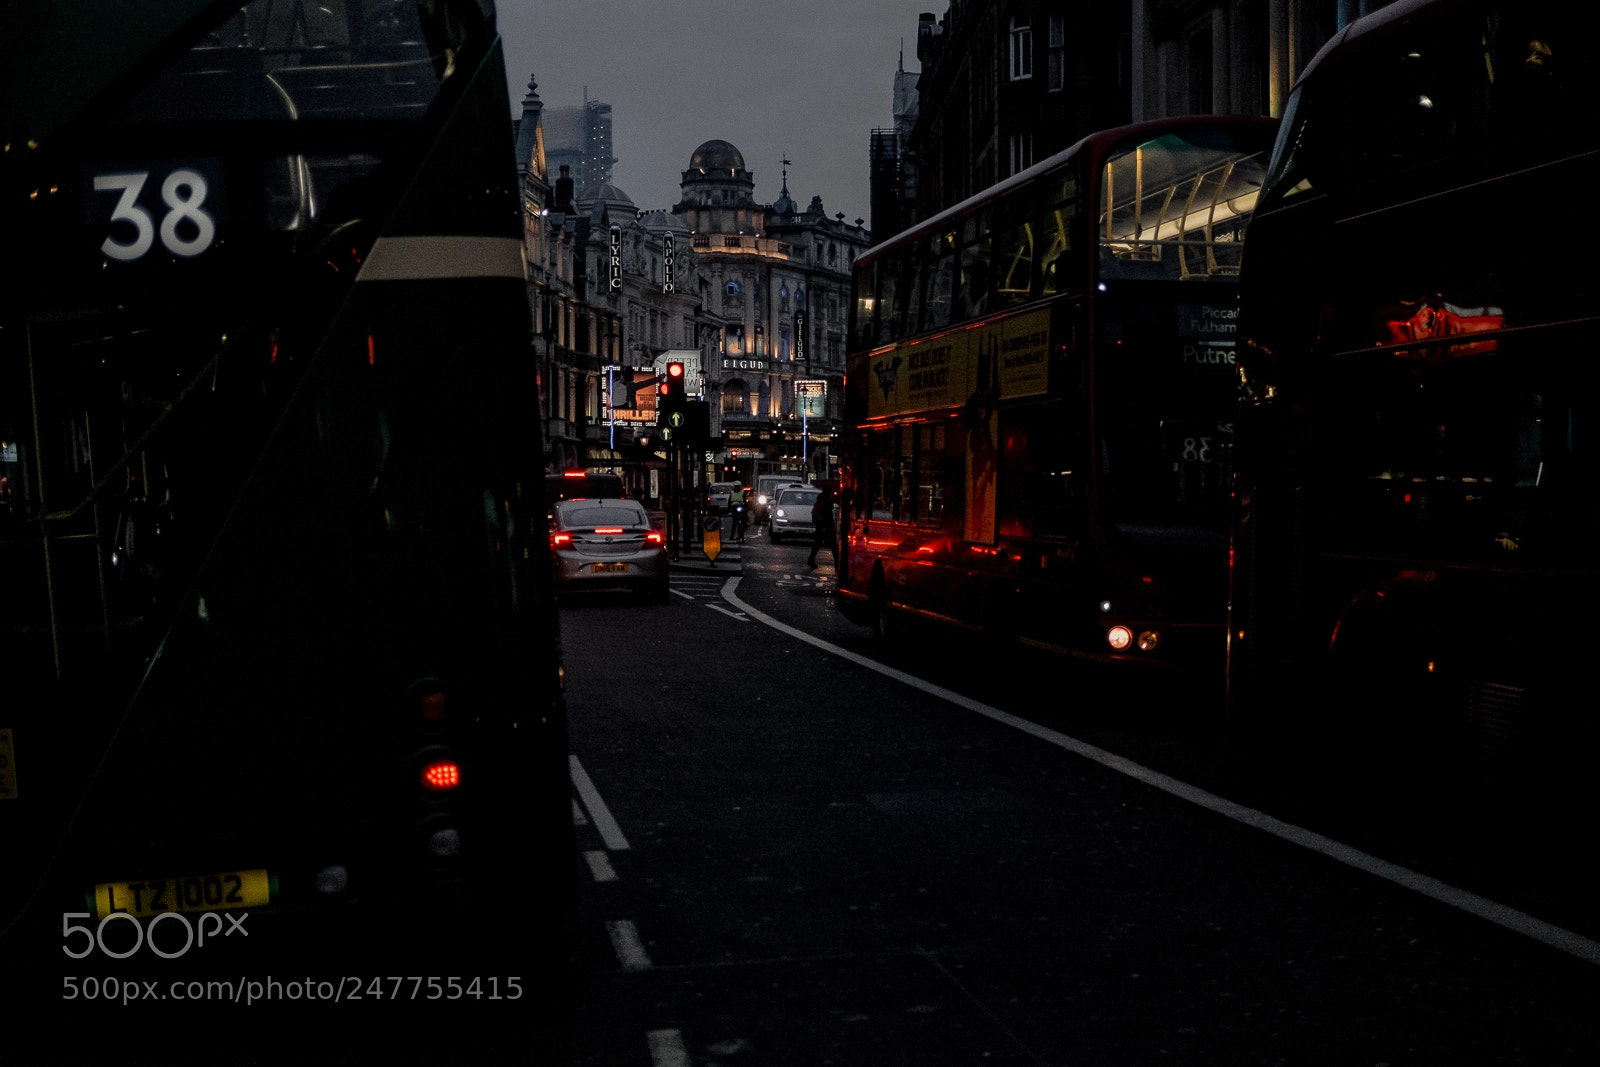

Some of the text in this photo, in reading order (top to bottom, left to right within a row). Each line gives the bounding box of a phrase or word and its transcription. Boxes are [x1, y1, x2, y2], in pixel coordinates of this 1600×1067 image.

[93, 168, 216, 261] 38
[611, 234, 621, 288] LYRIC
[664, 240, 673, 292] APOLLO
[1190, 319, 1237, 333] Fulham
[1183, 345, 1236, 365] Putne
[609, 409, 656, 421] HRILLER
